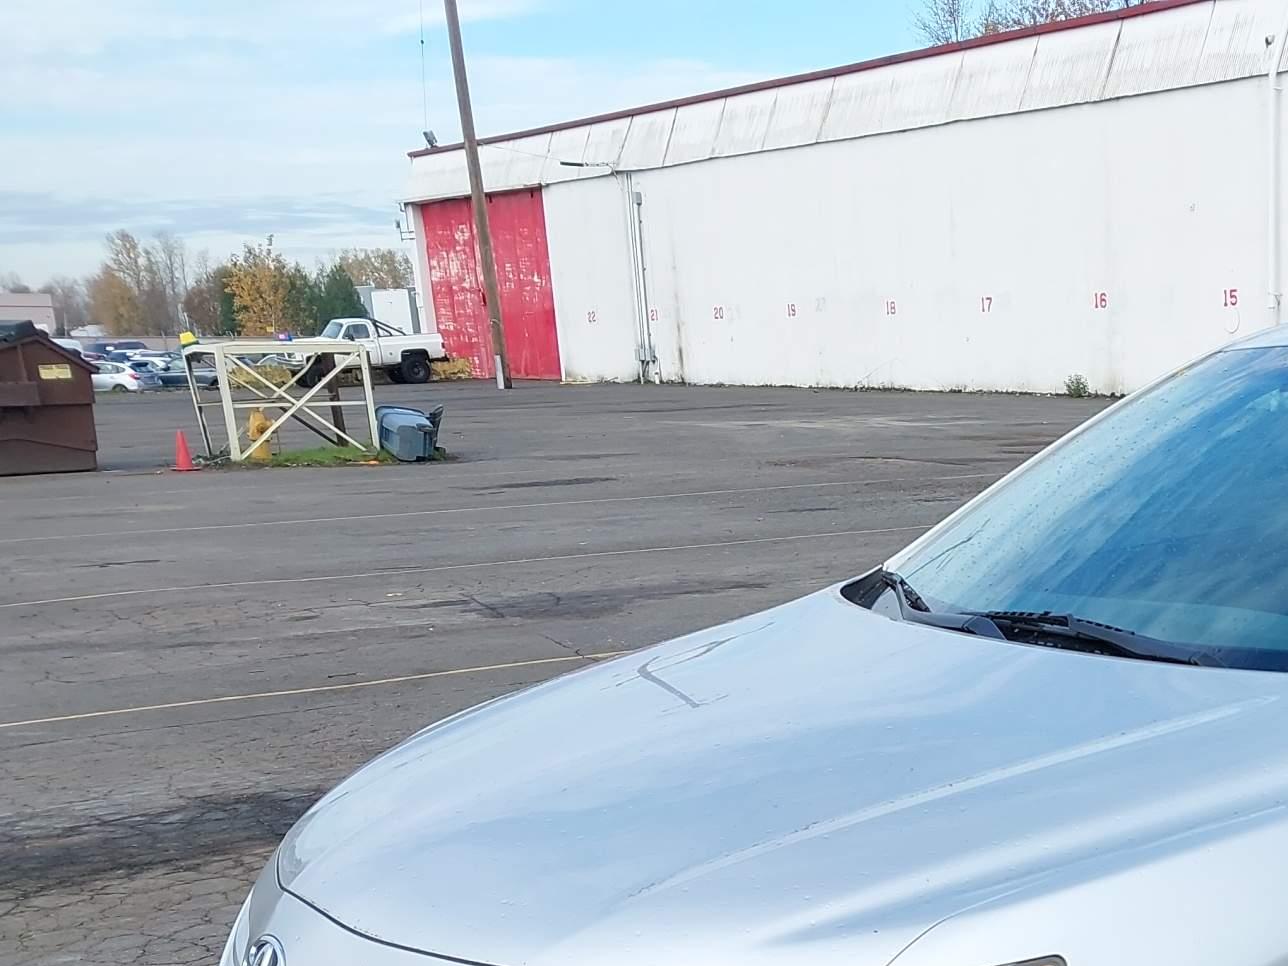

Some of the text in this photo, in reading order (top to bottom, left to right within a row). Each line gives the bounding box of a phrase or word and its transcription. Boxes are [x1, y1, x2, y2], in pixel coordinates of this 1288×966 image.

[981, 297, 993, 313] 17
[1094, 292, 1107, 309] 16
[1223, 289, 1238, 307] 15
[650, 309, 658, 321] 21
[713, 306, 724, 320] 20
[787, 303, 796, 317] 19
[886, 300, 896, 316] 18
[587, 311, 596, 323] 22
